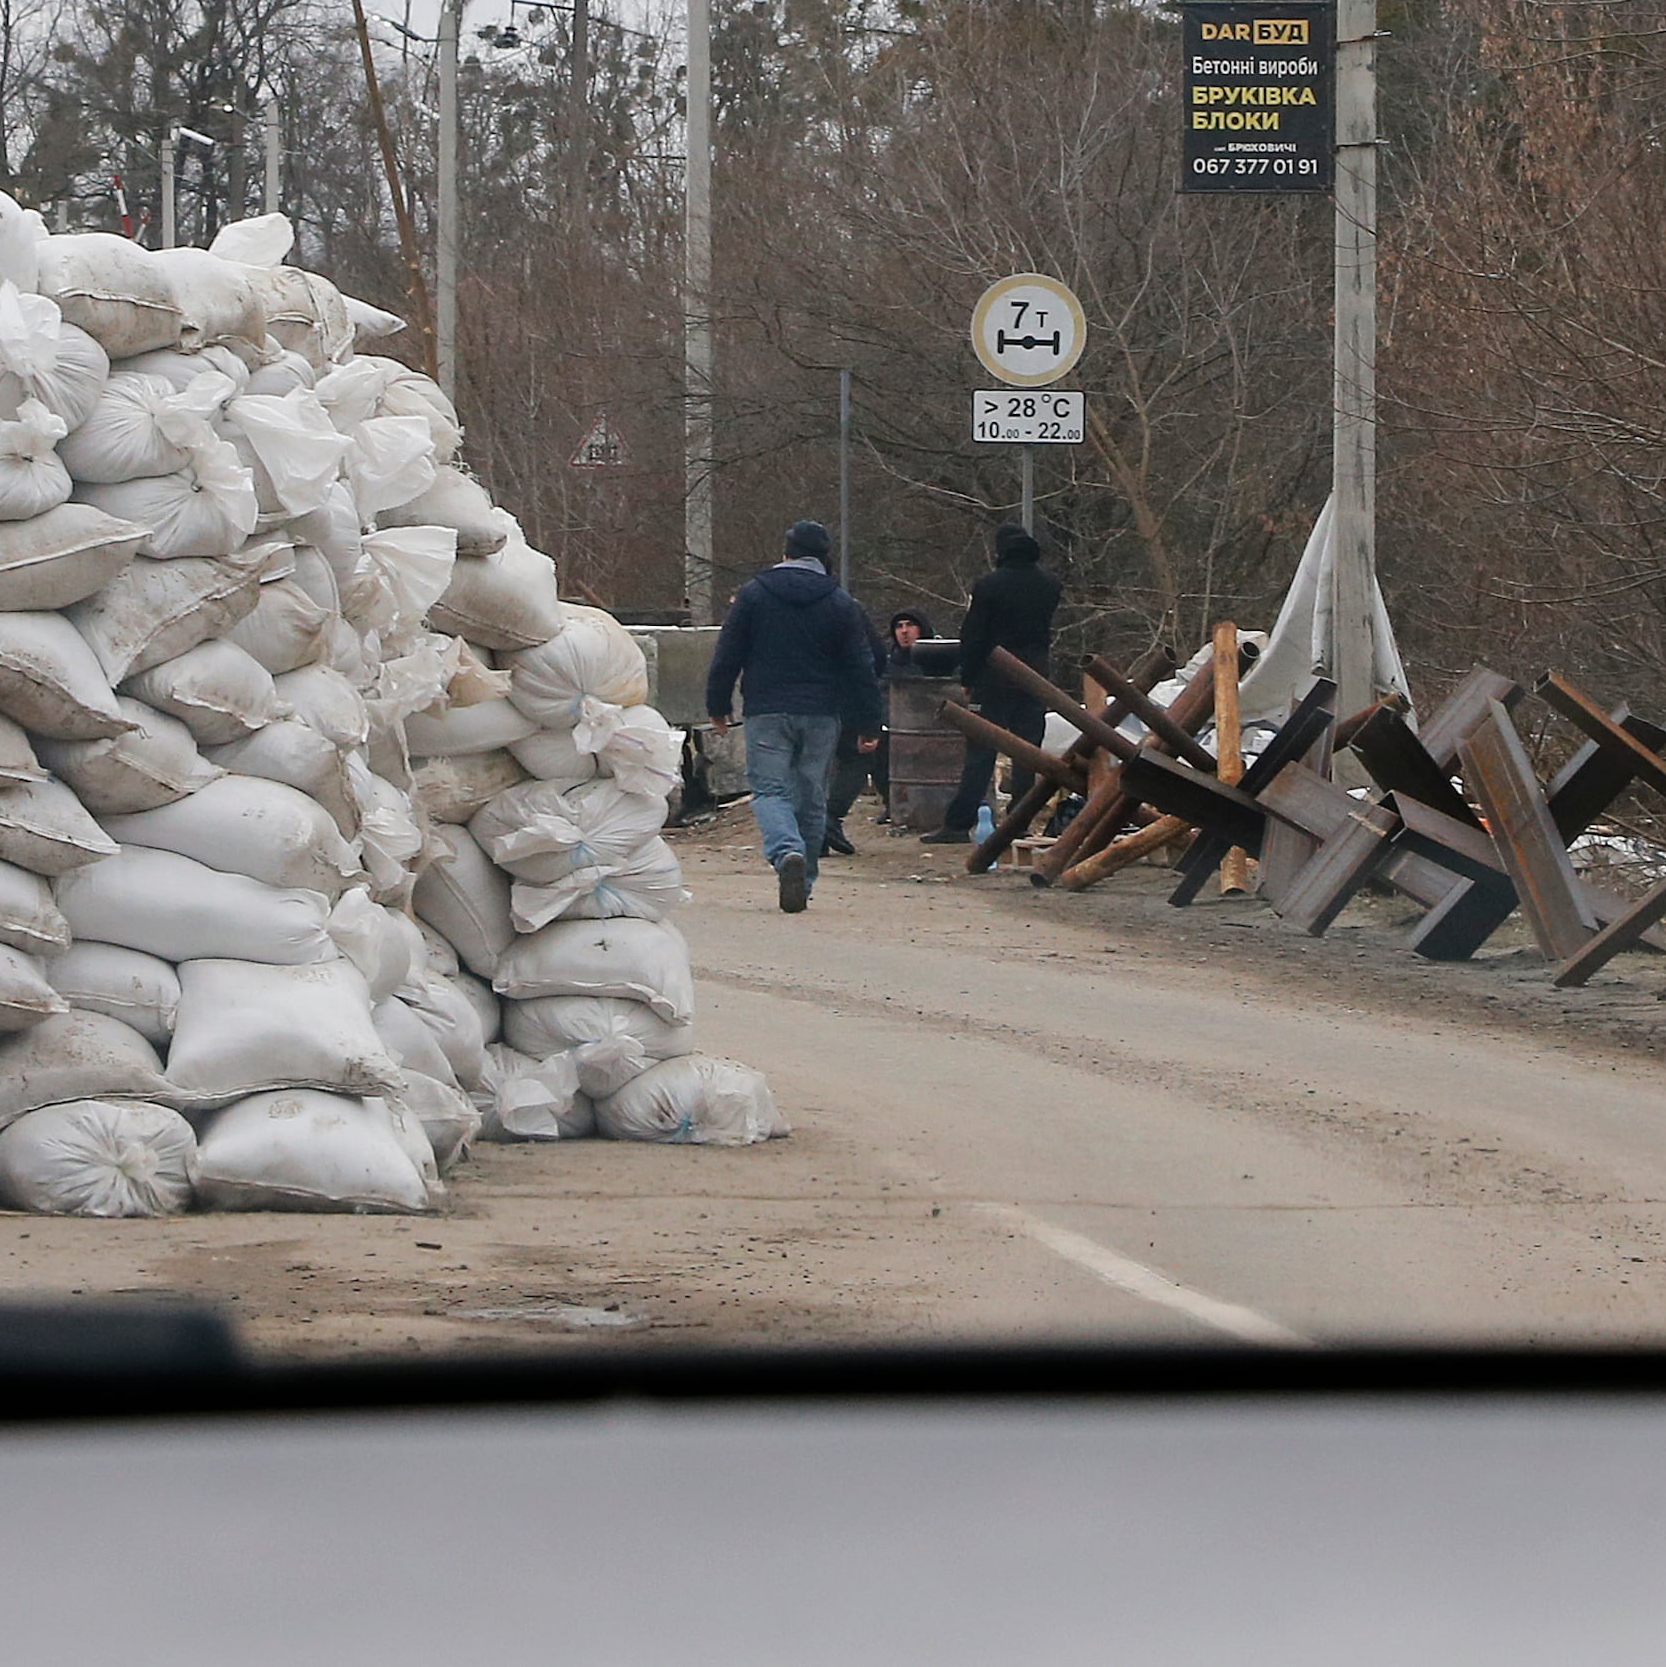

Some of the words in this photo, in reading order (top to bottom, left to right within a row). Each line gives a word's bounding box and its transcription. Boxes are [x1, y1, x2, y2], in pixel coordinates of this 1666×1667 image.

[1201, 24, 1250, 40] DAR
[1258, 24, 1304, 42] БУД
[1193, 57, 1254, 74] Бетонні
[1260, 57, 1318, 77] вироби
[1192, 87, 1316, 105] БРУКІВКА
[1192, 112, 1280, 130] БЛОКИ
[1193, 159, 1230, 174] 067
[1235, 159, 1268, 174] 377
[1008, 398, 1035, 417] 28
